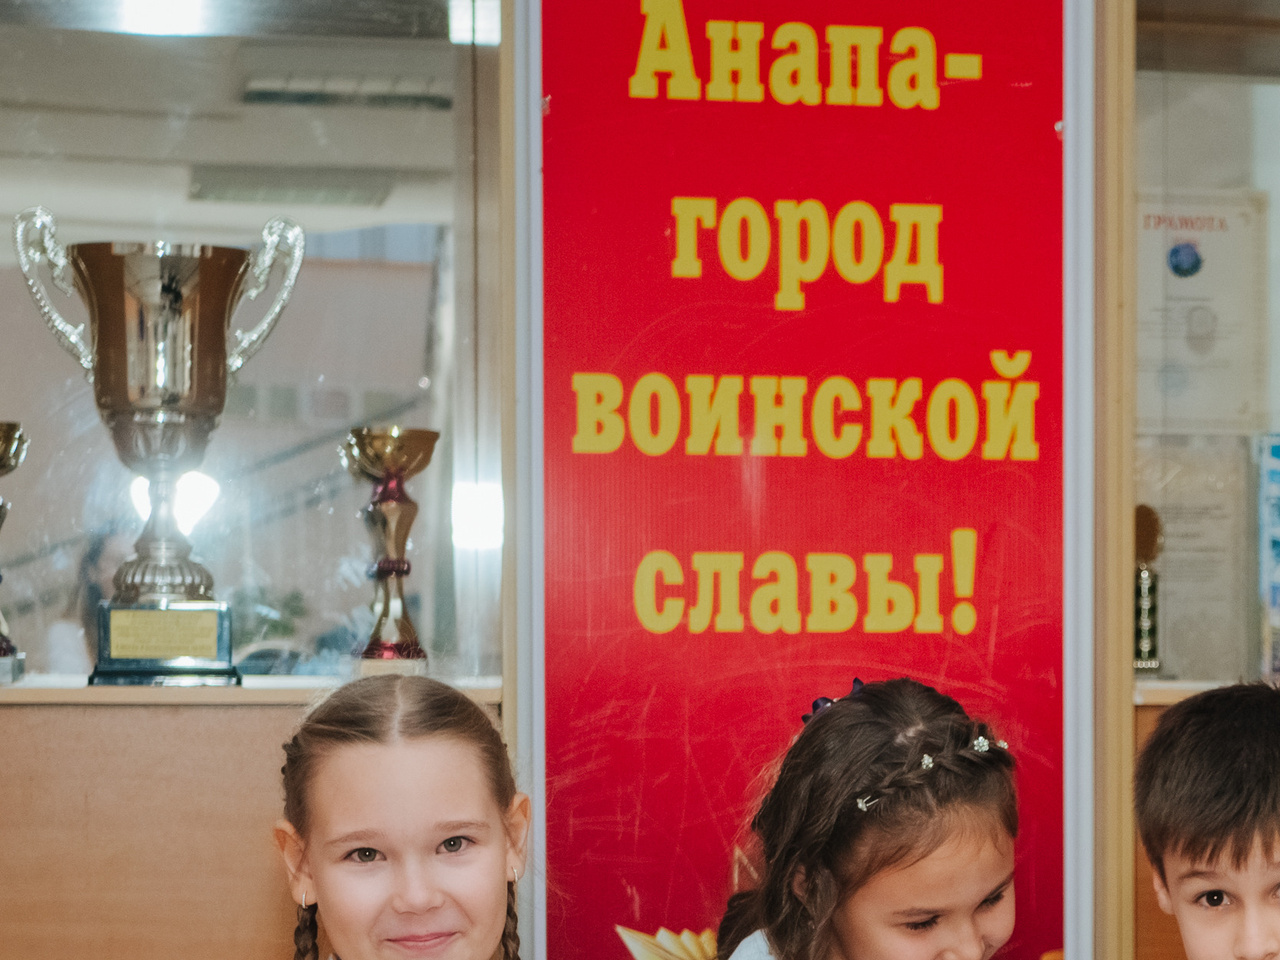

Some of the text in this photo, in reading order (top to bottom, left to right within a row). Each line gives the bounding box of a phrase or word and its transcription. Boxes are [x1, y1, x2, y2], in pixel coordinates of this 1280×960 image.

[629, 0, 983, 110] Анапа-
[671, 196, 944, 311] город
[572, 350, 1040, 461] воинской
[633, 527, 978, 635] славы!
